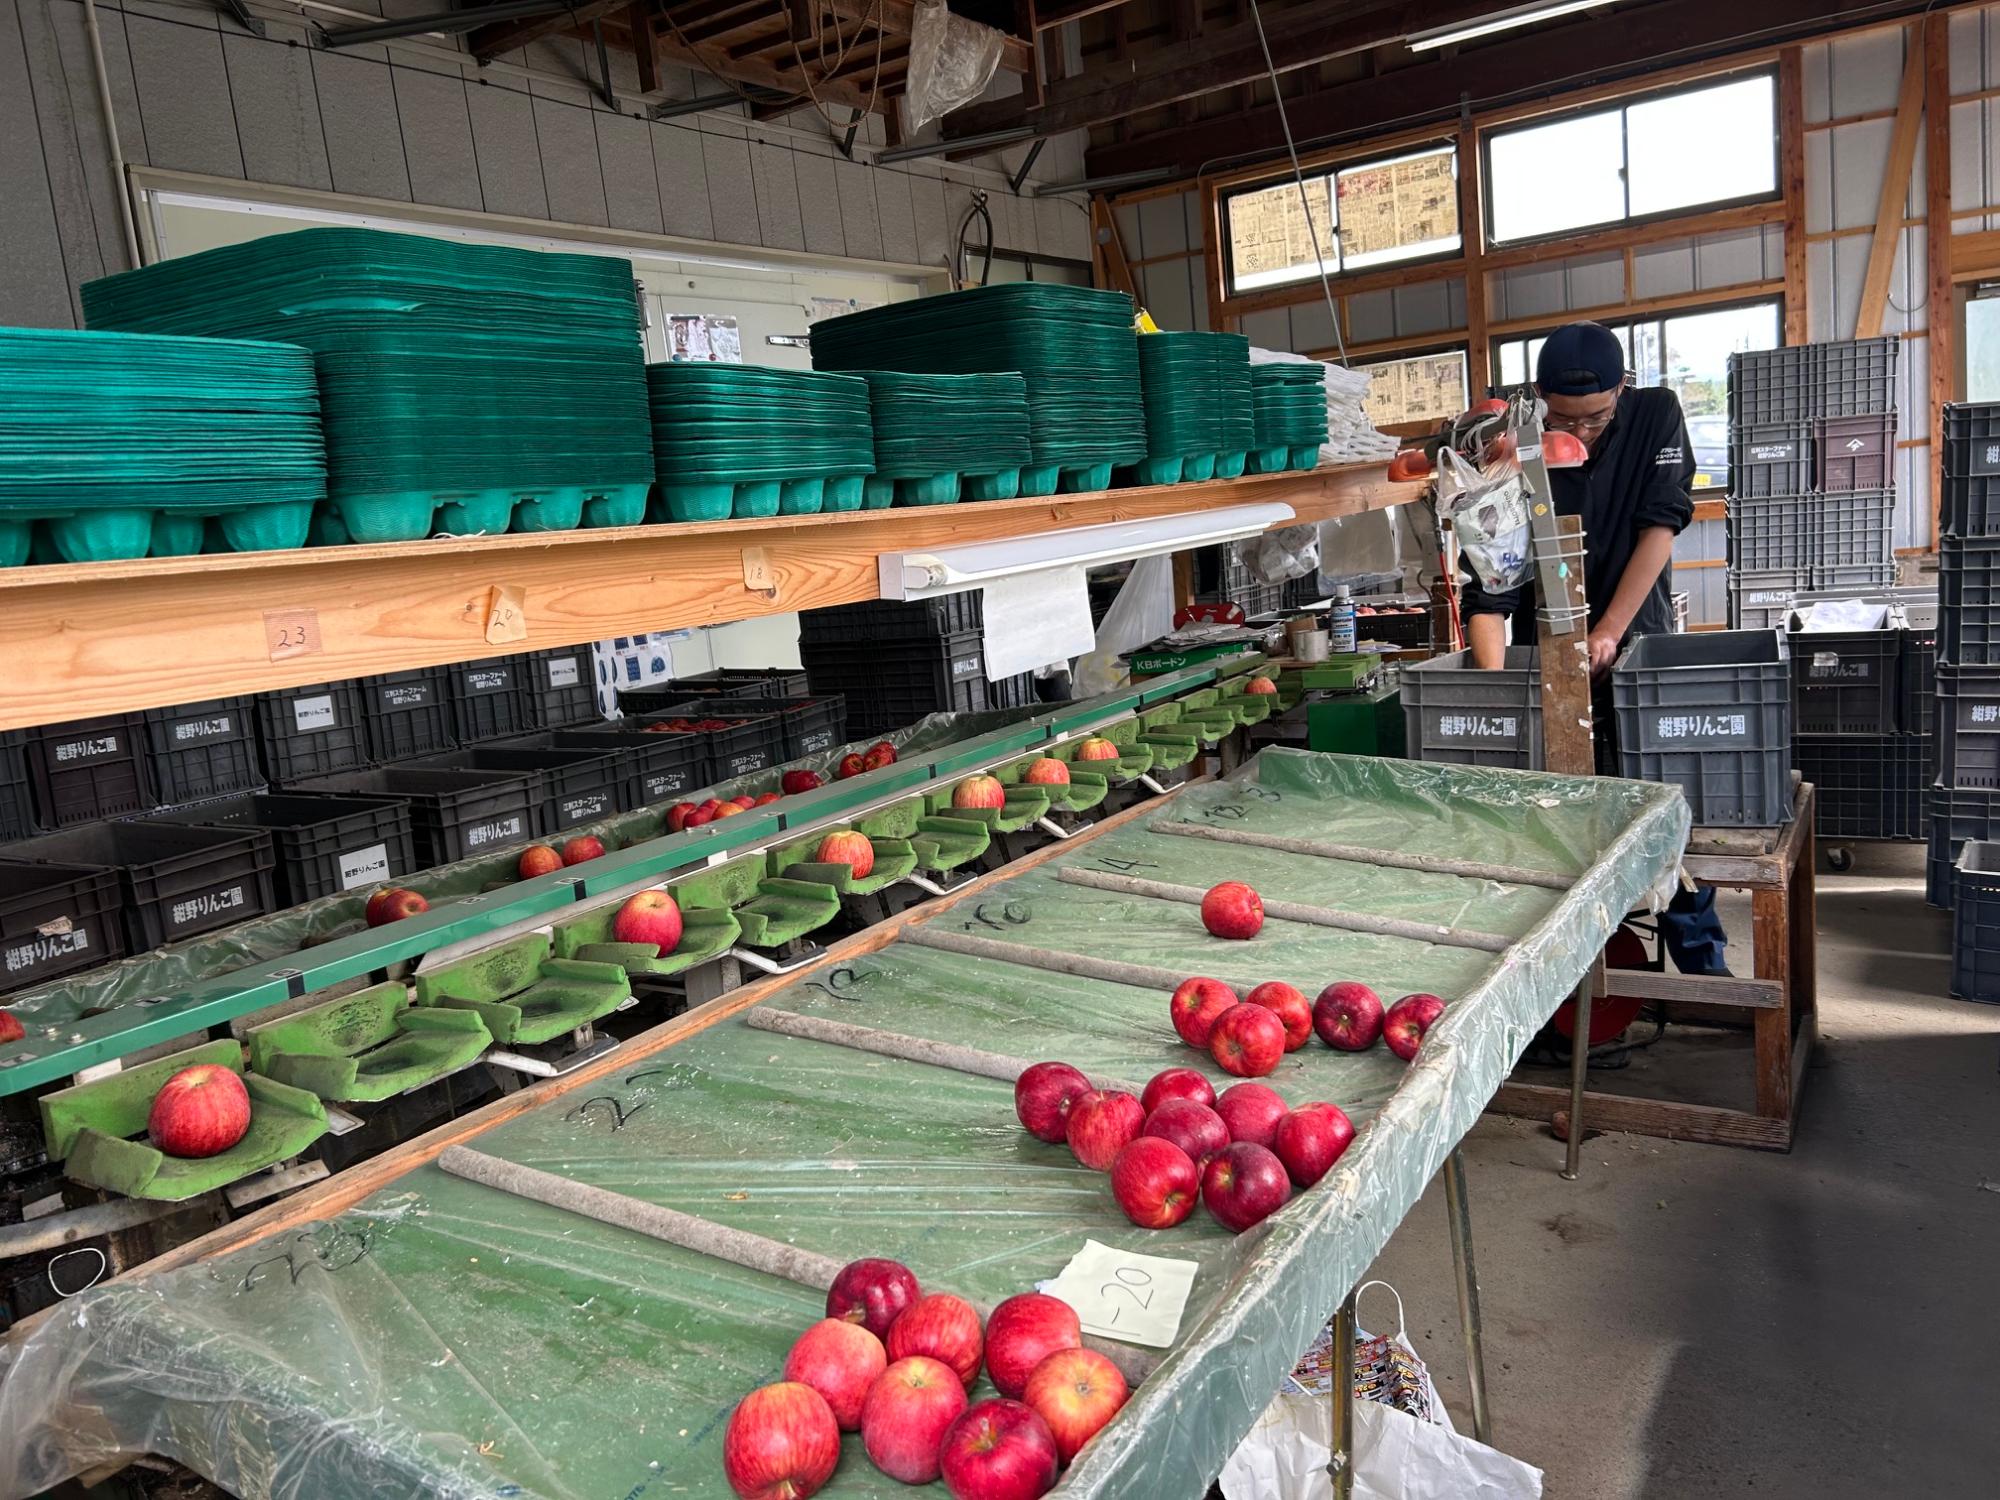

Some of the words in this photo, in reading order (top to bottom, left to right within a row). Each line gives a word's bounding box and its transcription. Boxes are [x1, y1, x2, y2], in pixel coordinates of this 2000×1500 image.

[492, 608, 512, 627] 20
[278, 626, 306, 647] 23
[1971, 705, 2000, 722] 紺野
[175, 717, 231, 740] 紺野りんご園
[1440, 716, 1516, 736] 紺野りんご園
[1658, 714, 1745, 737] 紺野りんご園
[56, 736, 117, 761] 紺野りんご園
[468, 817, 520, 846] 紺野りんご園
[172, 886, 244, 924] 紺野りんご園
[5, 928, 88, 972] 紺野りんご園
